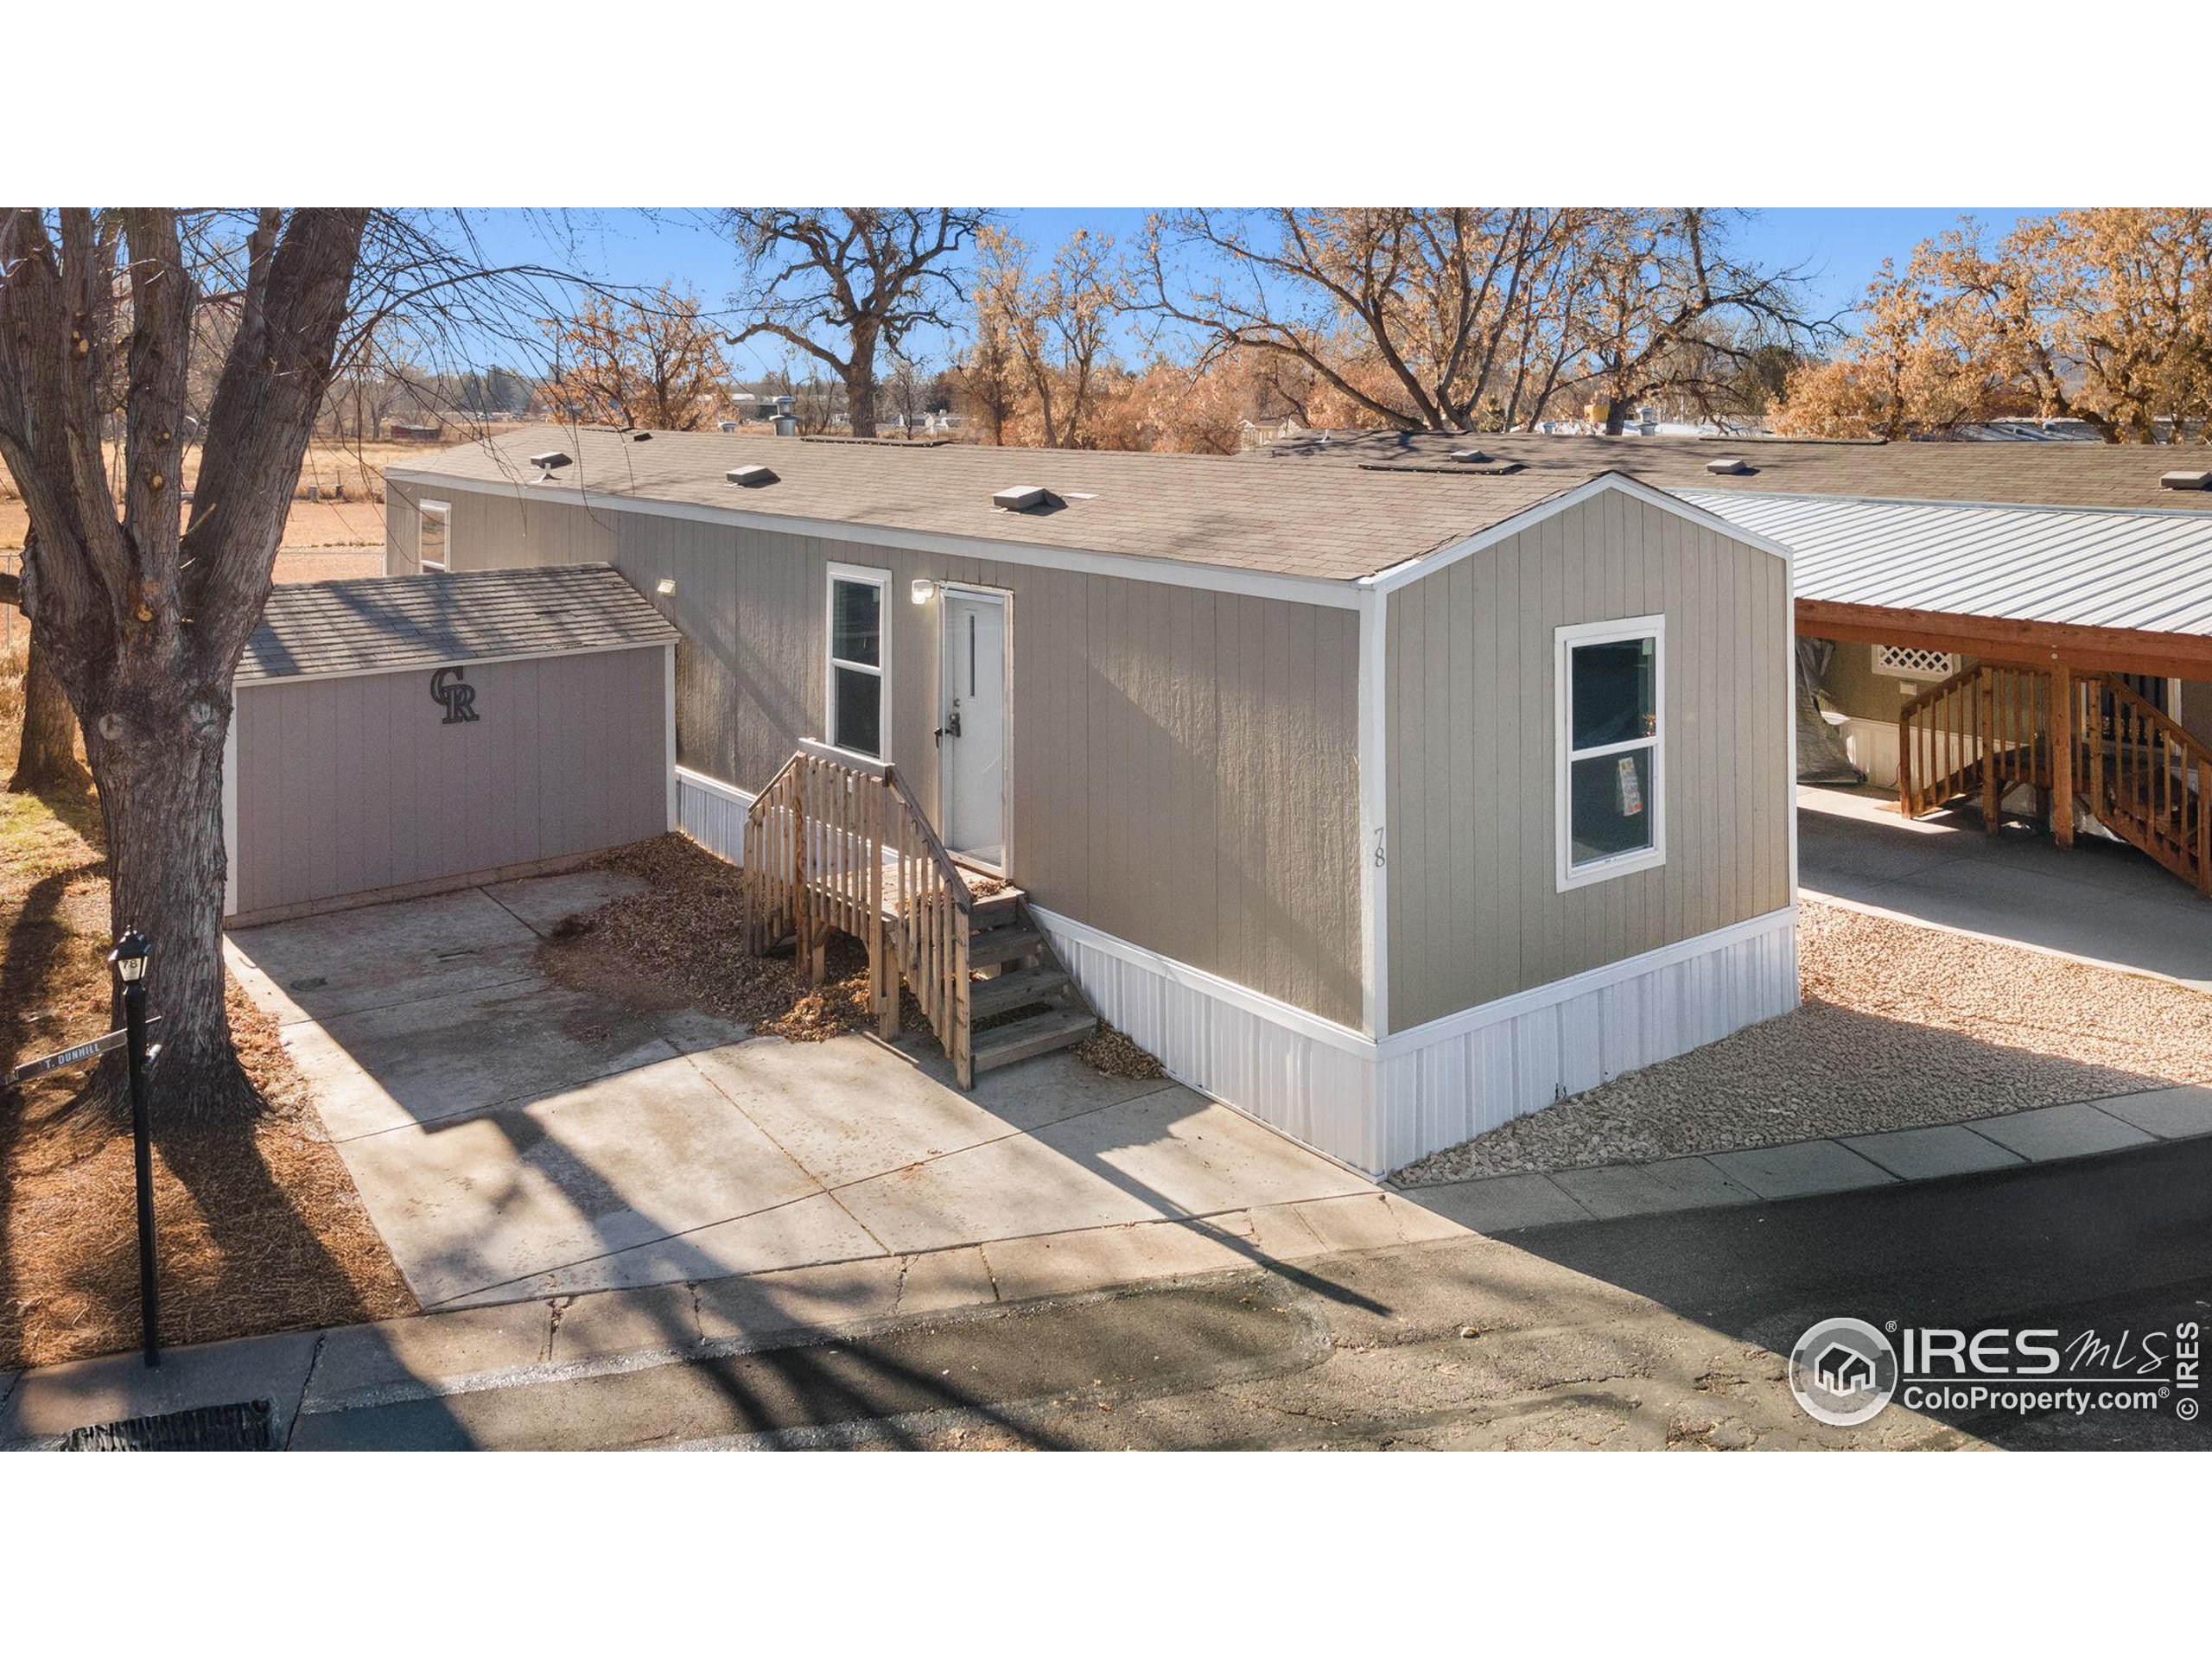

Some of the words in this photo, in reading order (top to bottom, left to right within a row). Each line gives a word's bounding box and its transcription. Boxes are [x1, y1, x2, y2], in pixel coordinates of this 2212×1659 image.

[1375, 826, 1385, 868] 78
[122, 959, 137, 969] 78
[58, 1044, 99, 1065] DUNHILL
